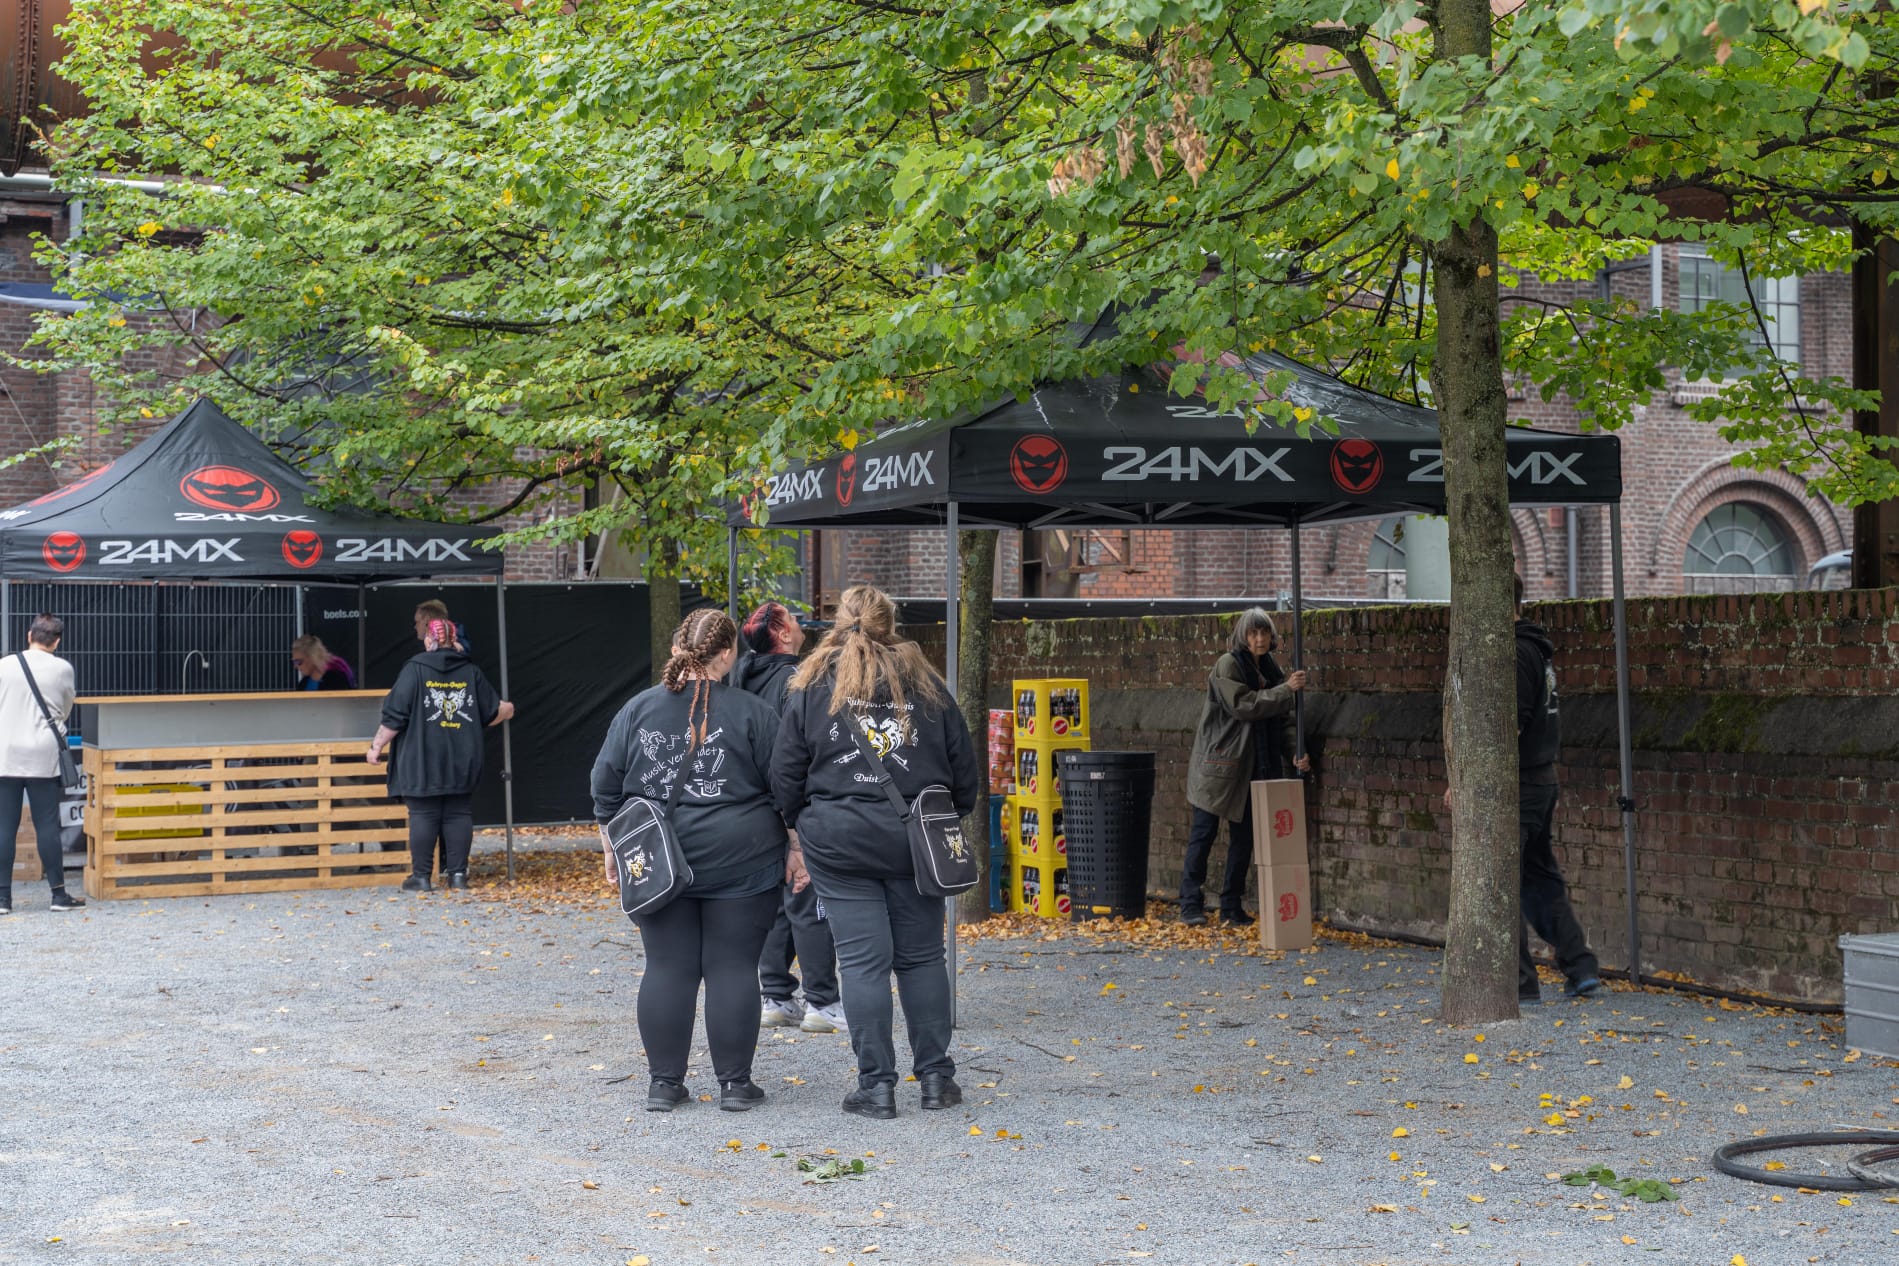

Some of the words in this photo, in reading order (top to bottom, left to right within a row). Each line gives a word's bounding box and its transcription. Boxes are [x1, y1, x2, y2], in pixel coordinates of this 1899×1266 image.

[862, 450, 935, 492] 24MX
[1101, 446, 1296, 482] 24MX
[1407, 448, 1588, 486] 2MX
[765, 467, 825, 506] 24MX
[174, 512, 317, 523] 24MX
[98, 538, 246, 564] 24MX
[335, 537, 472, 562] 24MX
[640, 760, 667, 784] Musik
